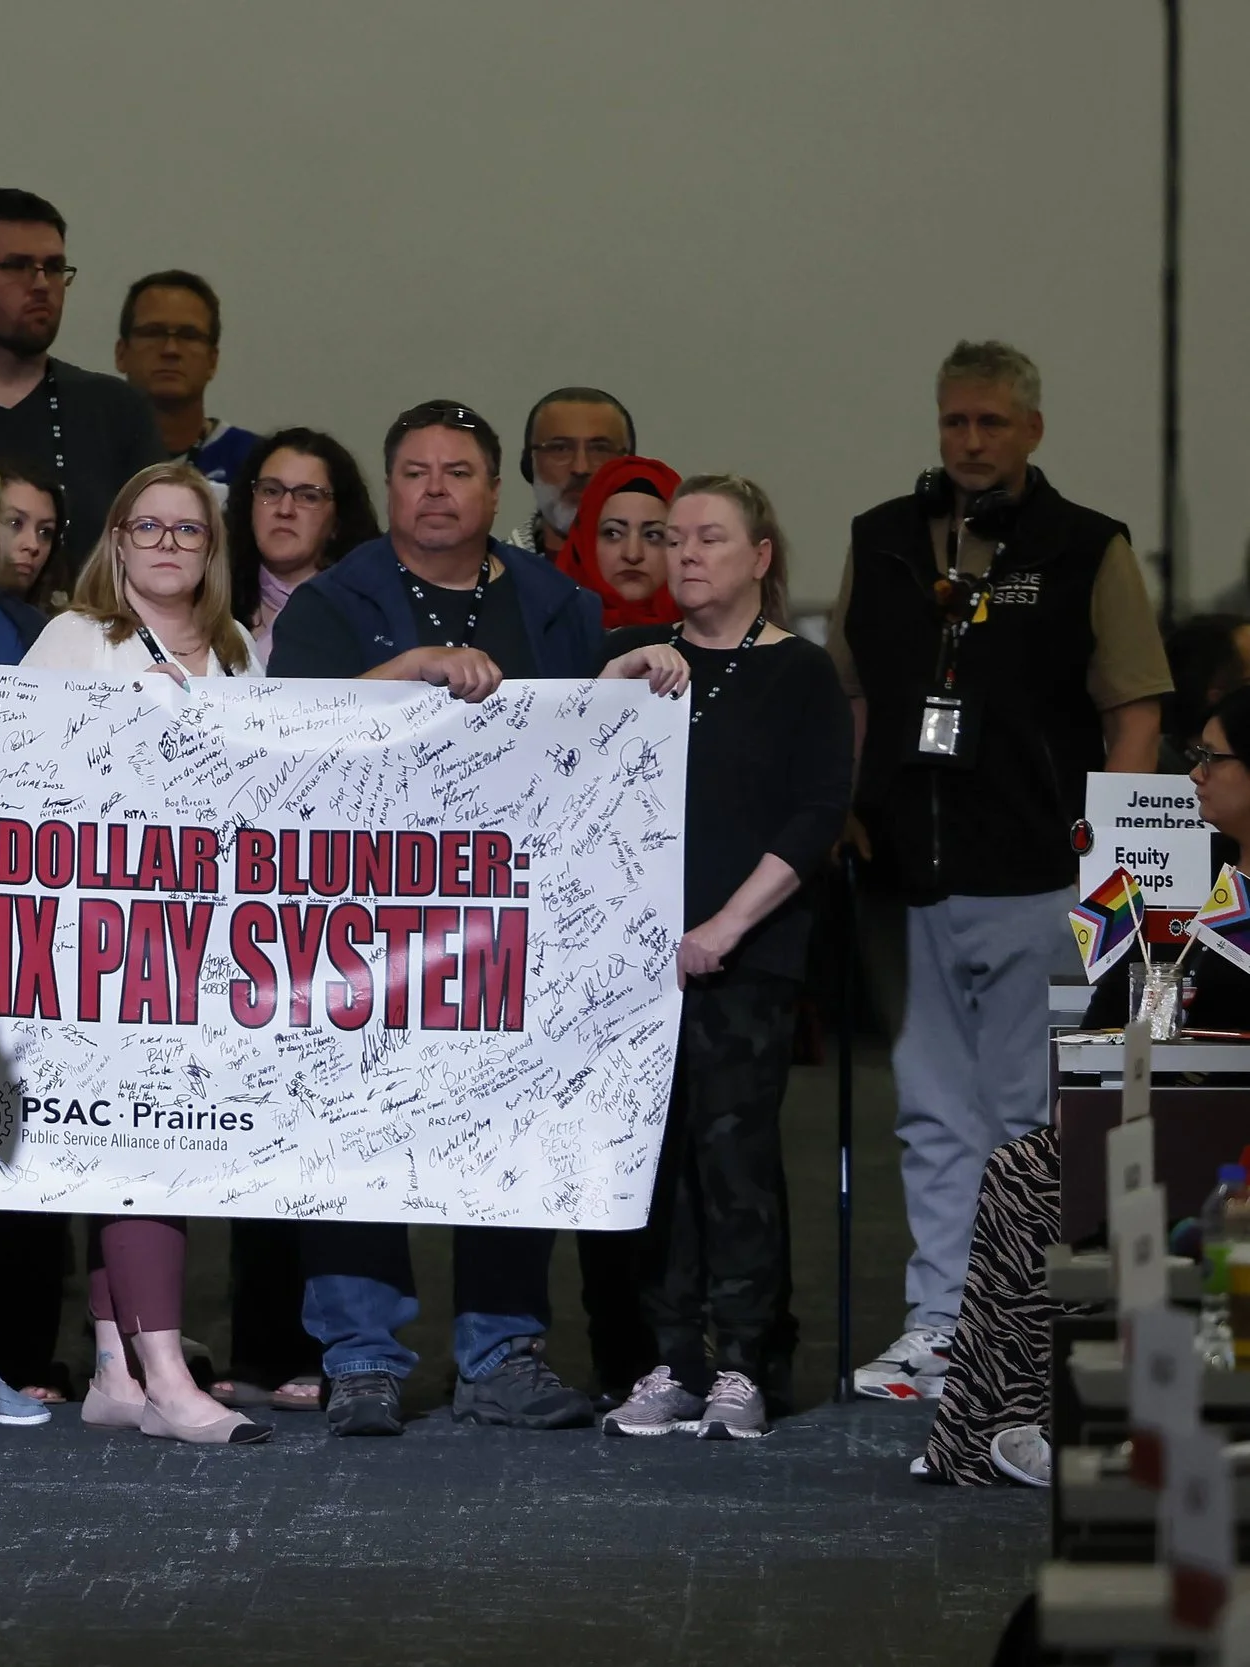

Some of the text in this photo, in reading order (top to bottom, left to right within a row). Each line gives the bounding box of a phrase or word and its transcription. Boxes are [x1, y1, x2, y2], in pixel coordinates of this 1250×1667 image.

[1010, 572, 1041, 584] SJE
[993, 592, 1037, 604] SESJ
[244, 711, 265, 731] Stop
[184, 764, 194, 776] do
[1127, 791, 1194, 809] Jeunes
[123, 810, 147, 820] RITA
[1116, 813, 1205, 829] membres
[235, 829, 530, 898] BLUNDER:
[1115, 847, 1169, 869] Equity
[1133, 875, 1173, 892] oups
[77, 897, 213, 1025] PAY
[228, 900, 529, 1032] SYSTEM
[121, 1033, 137, 1050] I
[140, 1035, 163, 1044] need
[119, 1080, 137, 1090] Well
[118, 1090, 125, 1098] to
[22, 1097, 254, 1131] PSAC Prairies
[22, 1130, 59, 1145] Public
[64, 1131, 107, 1146] Service
[111, 1133, 160, 1149] Alliance
[164, 1136, 175, 1149] of
[180, 1136, 228, 1150] Canada
